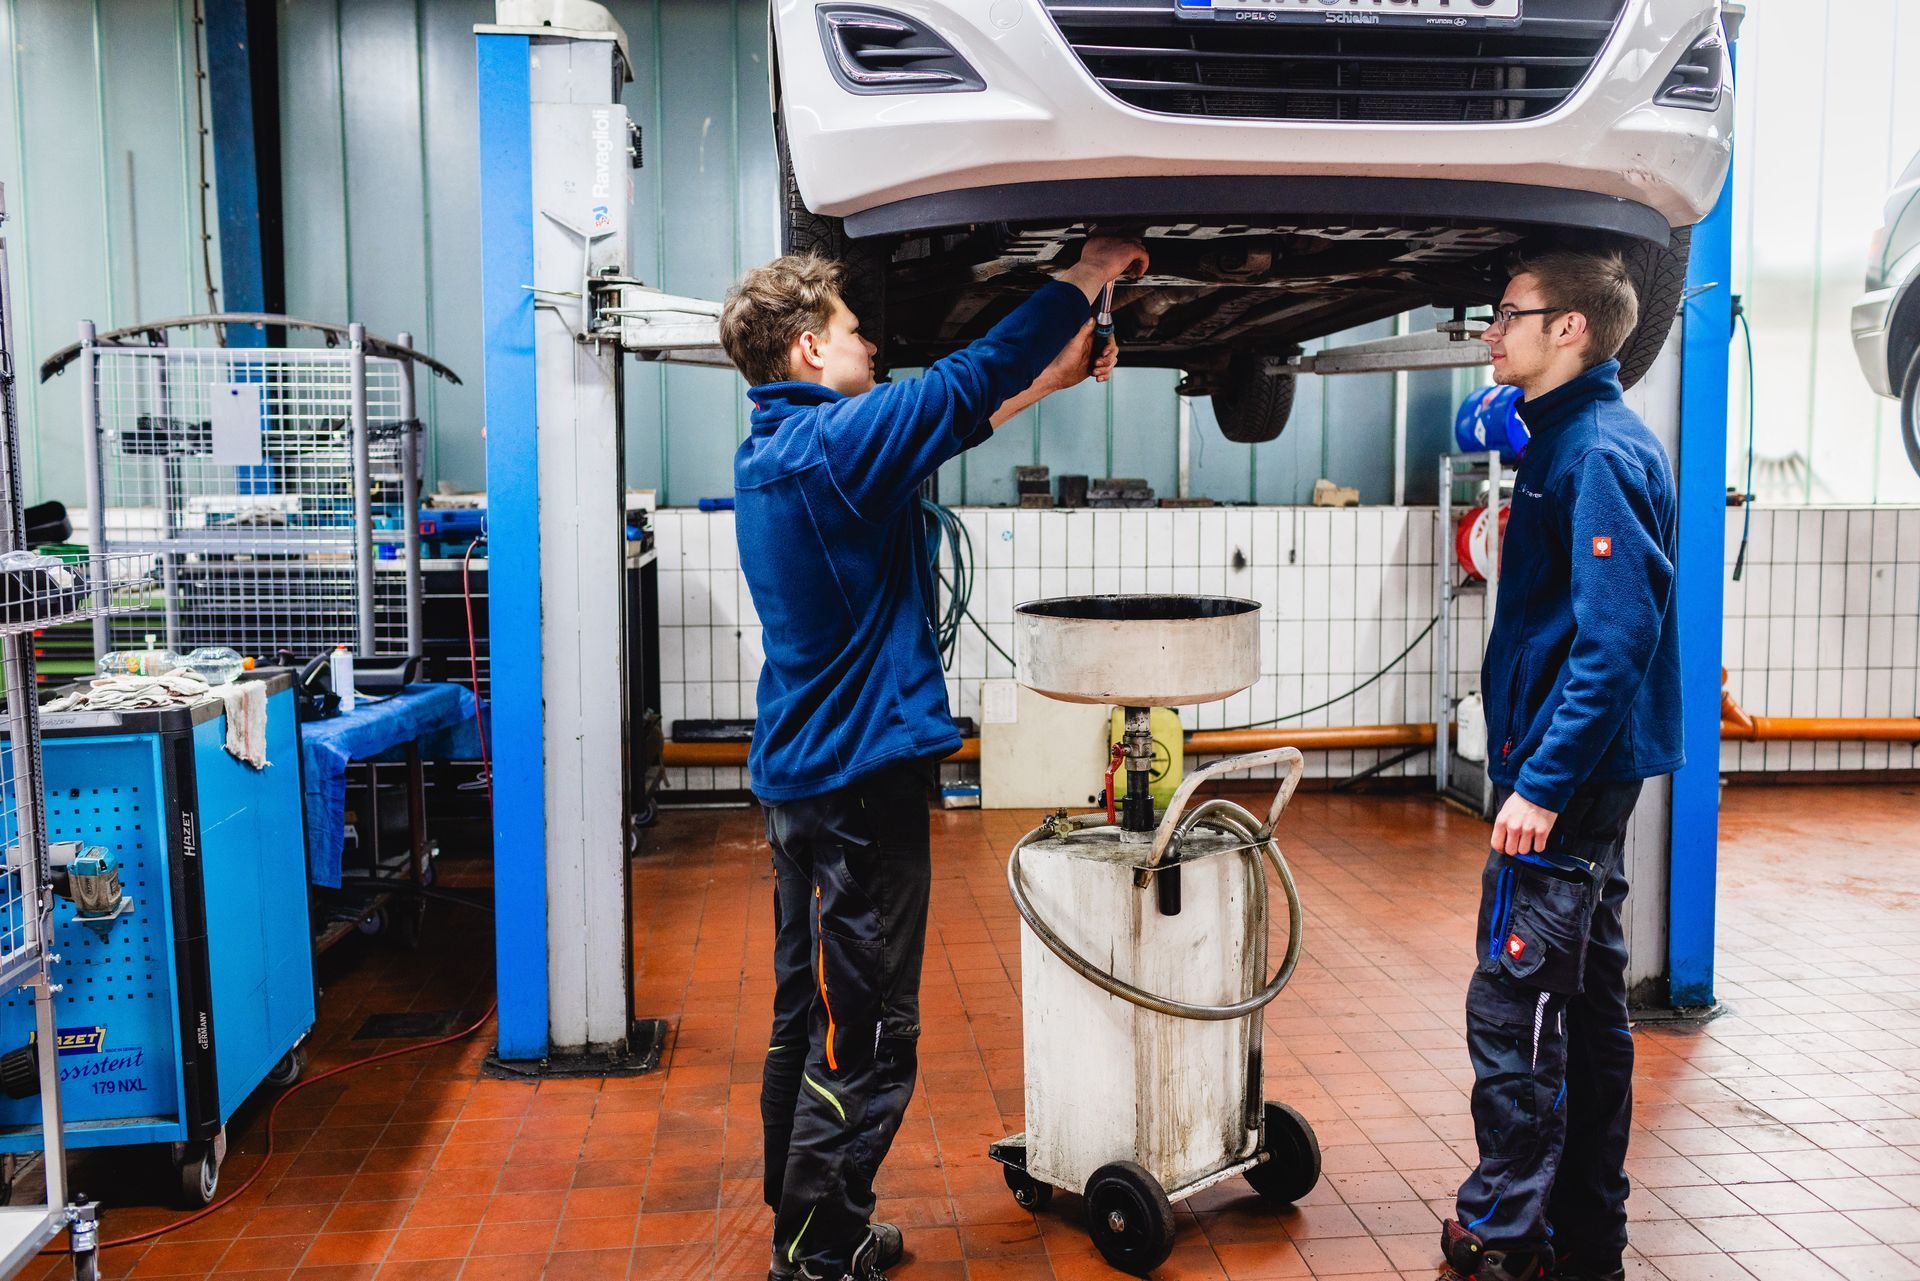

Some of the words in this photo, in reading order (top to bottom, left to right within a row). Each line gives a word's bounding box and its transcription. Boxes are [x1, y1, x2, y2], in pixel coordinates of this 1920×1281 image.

[1235, 12, 1265, 20] OPEL
[592, 109, 613, 198] Ravaglioli
[182, 811, 196, 857] HAZET
[199, 1011, 209, 1050] GERMANY
[59, 1050, 144, 1082] ssistent
[92, 1080, 116, 1095] 179
[118, 1078, 147, 1093] NXL
